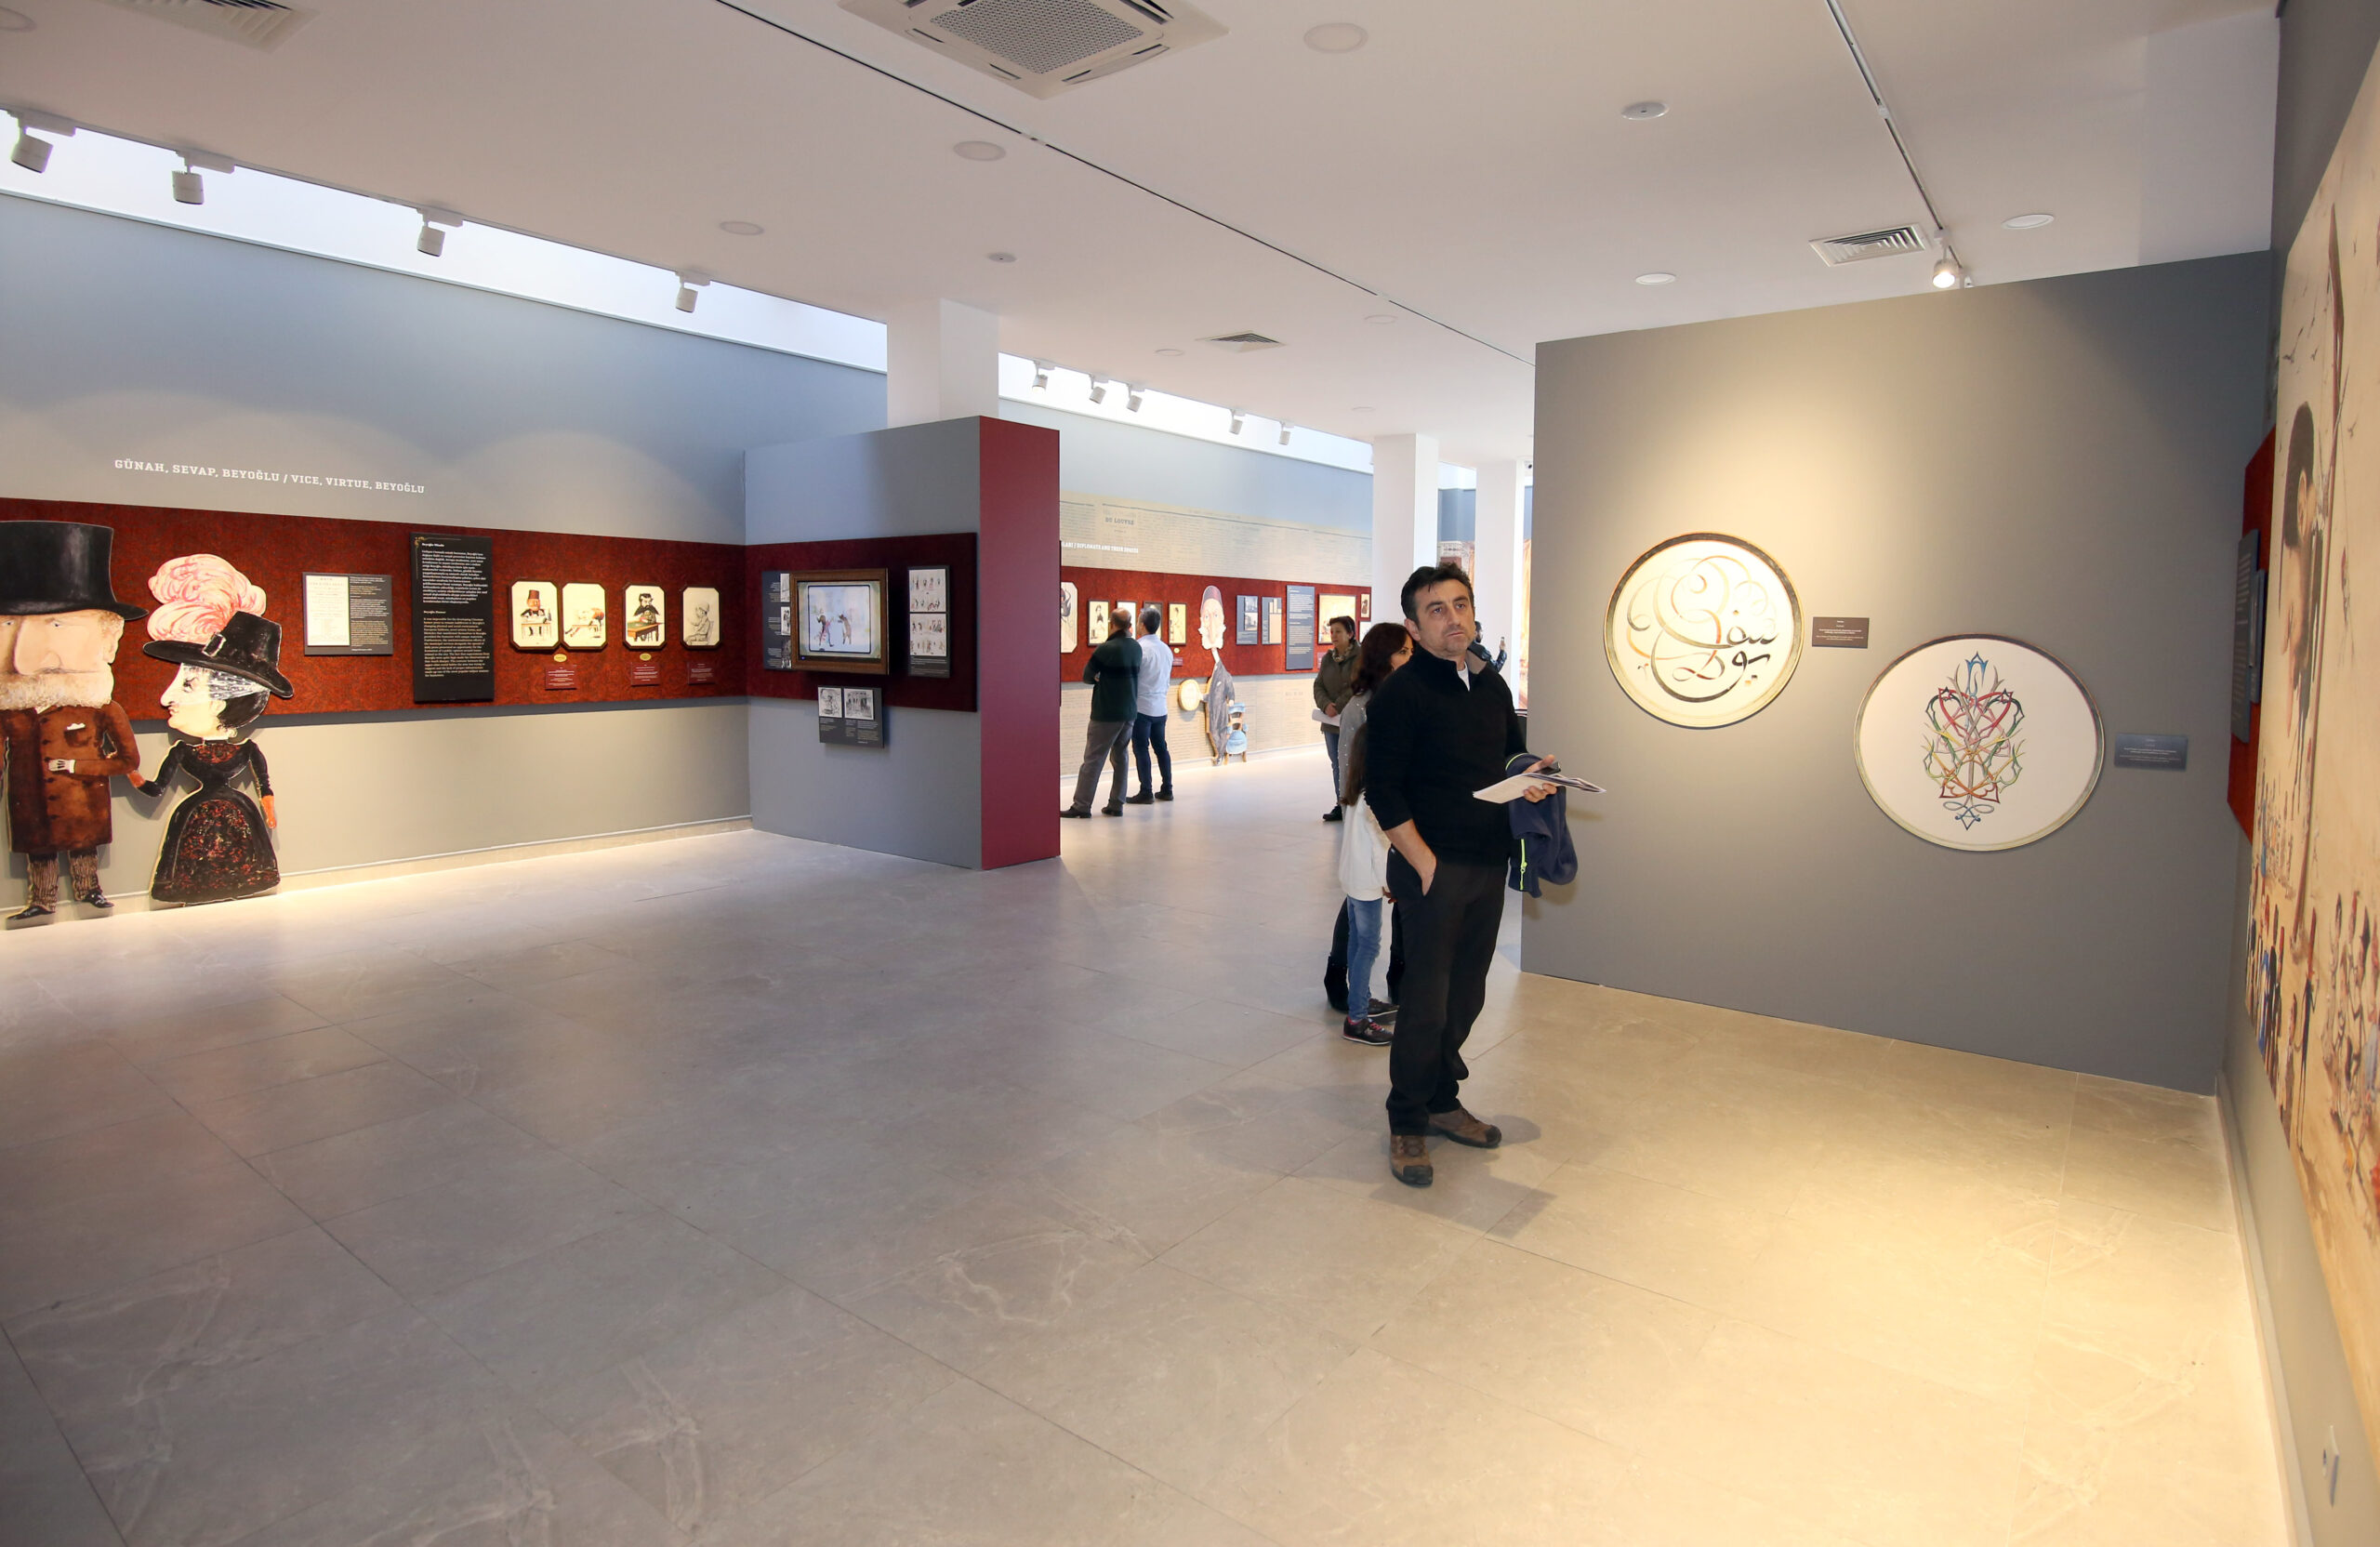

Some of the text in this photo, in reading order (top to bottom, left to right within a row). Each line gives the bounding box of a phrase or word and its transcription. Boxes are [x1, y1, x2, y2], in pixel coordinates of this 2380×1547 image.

[114, 458, 169, 474] GÜNAH,
[173, 465, 218, 478] SEVAP,
[222, 469, 280, 482] BEYOĞLU
[291, 474, 323, 486] VICE,
[325, 477, 373, 490] VIRTUE,
[376, 482, 425, 494] BEYOĞLU
